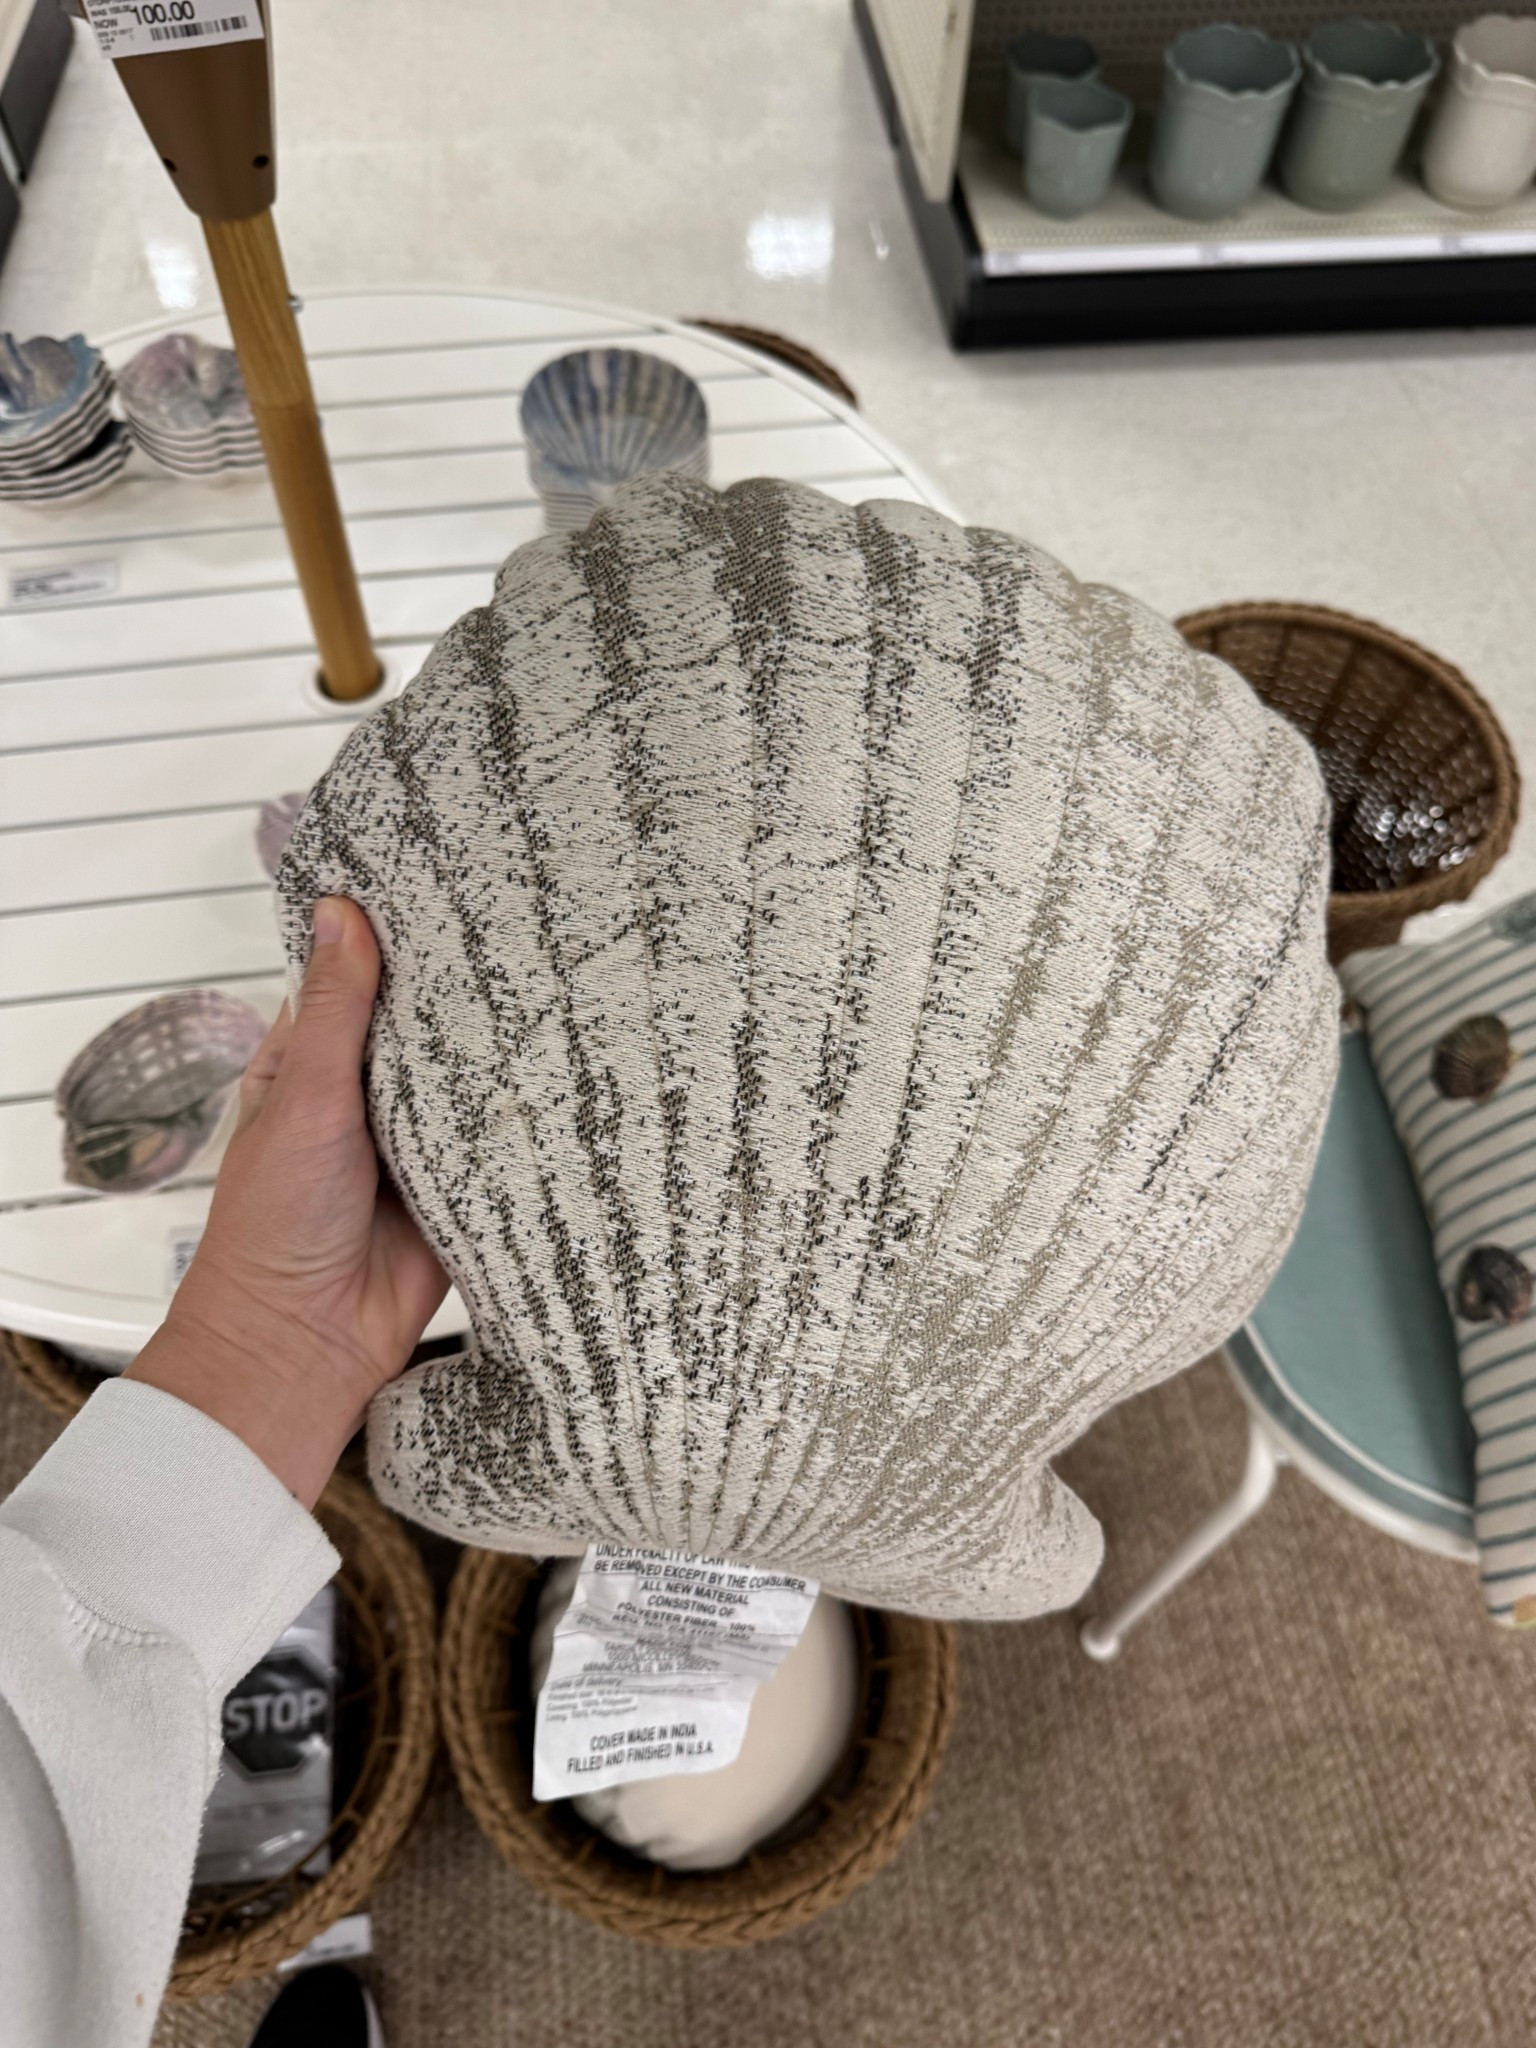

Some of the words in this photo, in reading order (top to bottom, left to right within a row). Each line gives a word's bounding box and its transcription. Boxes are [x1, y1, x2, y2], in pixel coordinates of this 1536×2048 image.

[94, 19, 118, 29] NOW
[130, 0, 195, 25] 100.00
[594, 1560, 609, 1571] BE
[610, 1560, 662, 1576] REMOVED
[663, 1565, 708, 1580] EXCEPT
[708, 1572, 725, 1585] BY
[727, 1574, 749, 1588] THE
[749, 1576, 806, 1592] CONSUMER
[640, 1580, 663, 1591] ALL
[665, 1582, 693, 1594] NEW
[693, 1586, 749, 1605] MATERIAL
[647, 1595, 716, 1615] CONSISTING
[718, 1606, 735, 1616] OF
[683, 1615, 717, 1628] FIBER
[225, 1687, 329, 1738] STOP
[590, 1731, 625, 1751] COVER
[627, 1726, 656, 1743] MADE
[657, 1725, 668, 1739] IN
[670, 1722, 697, 1739] INDIA
[567, 1754, 603, 1773] FILLED
[604, 1749, 625, 1766] AND
[626, 1742, 672, 1762] FINISHED
[675, 1741, 685, 1755] IN
